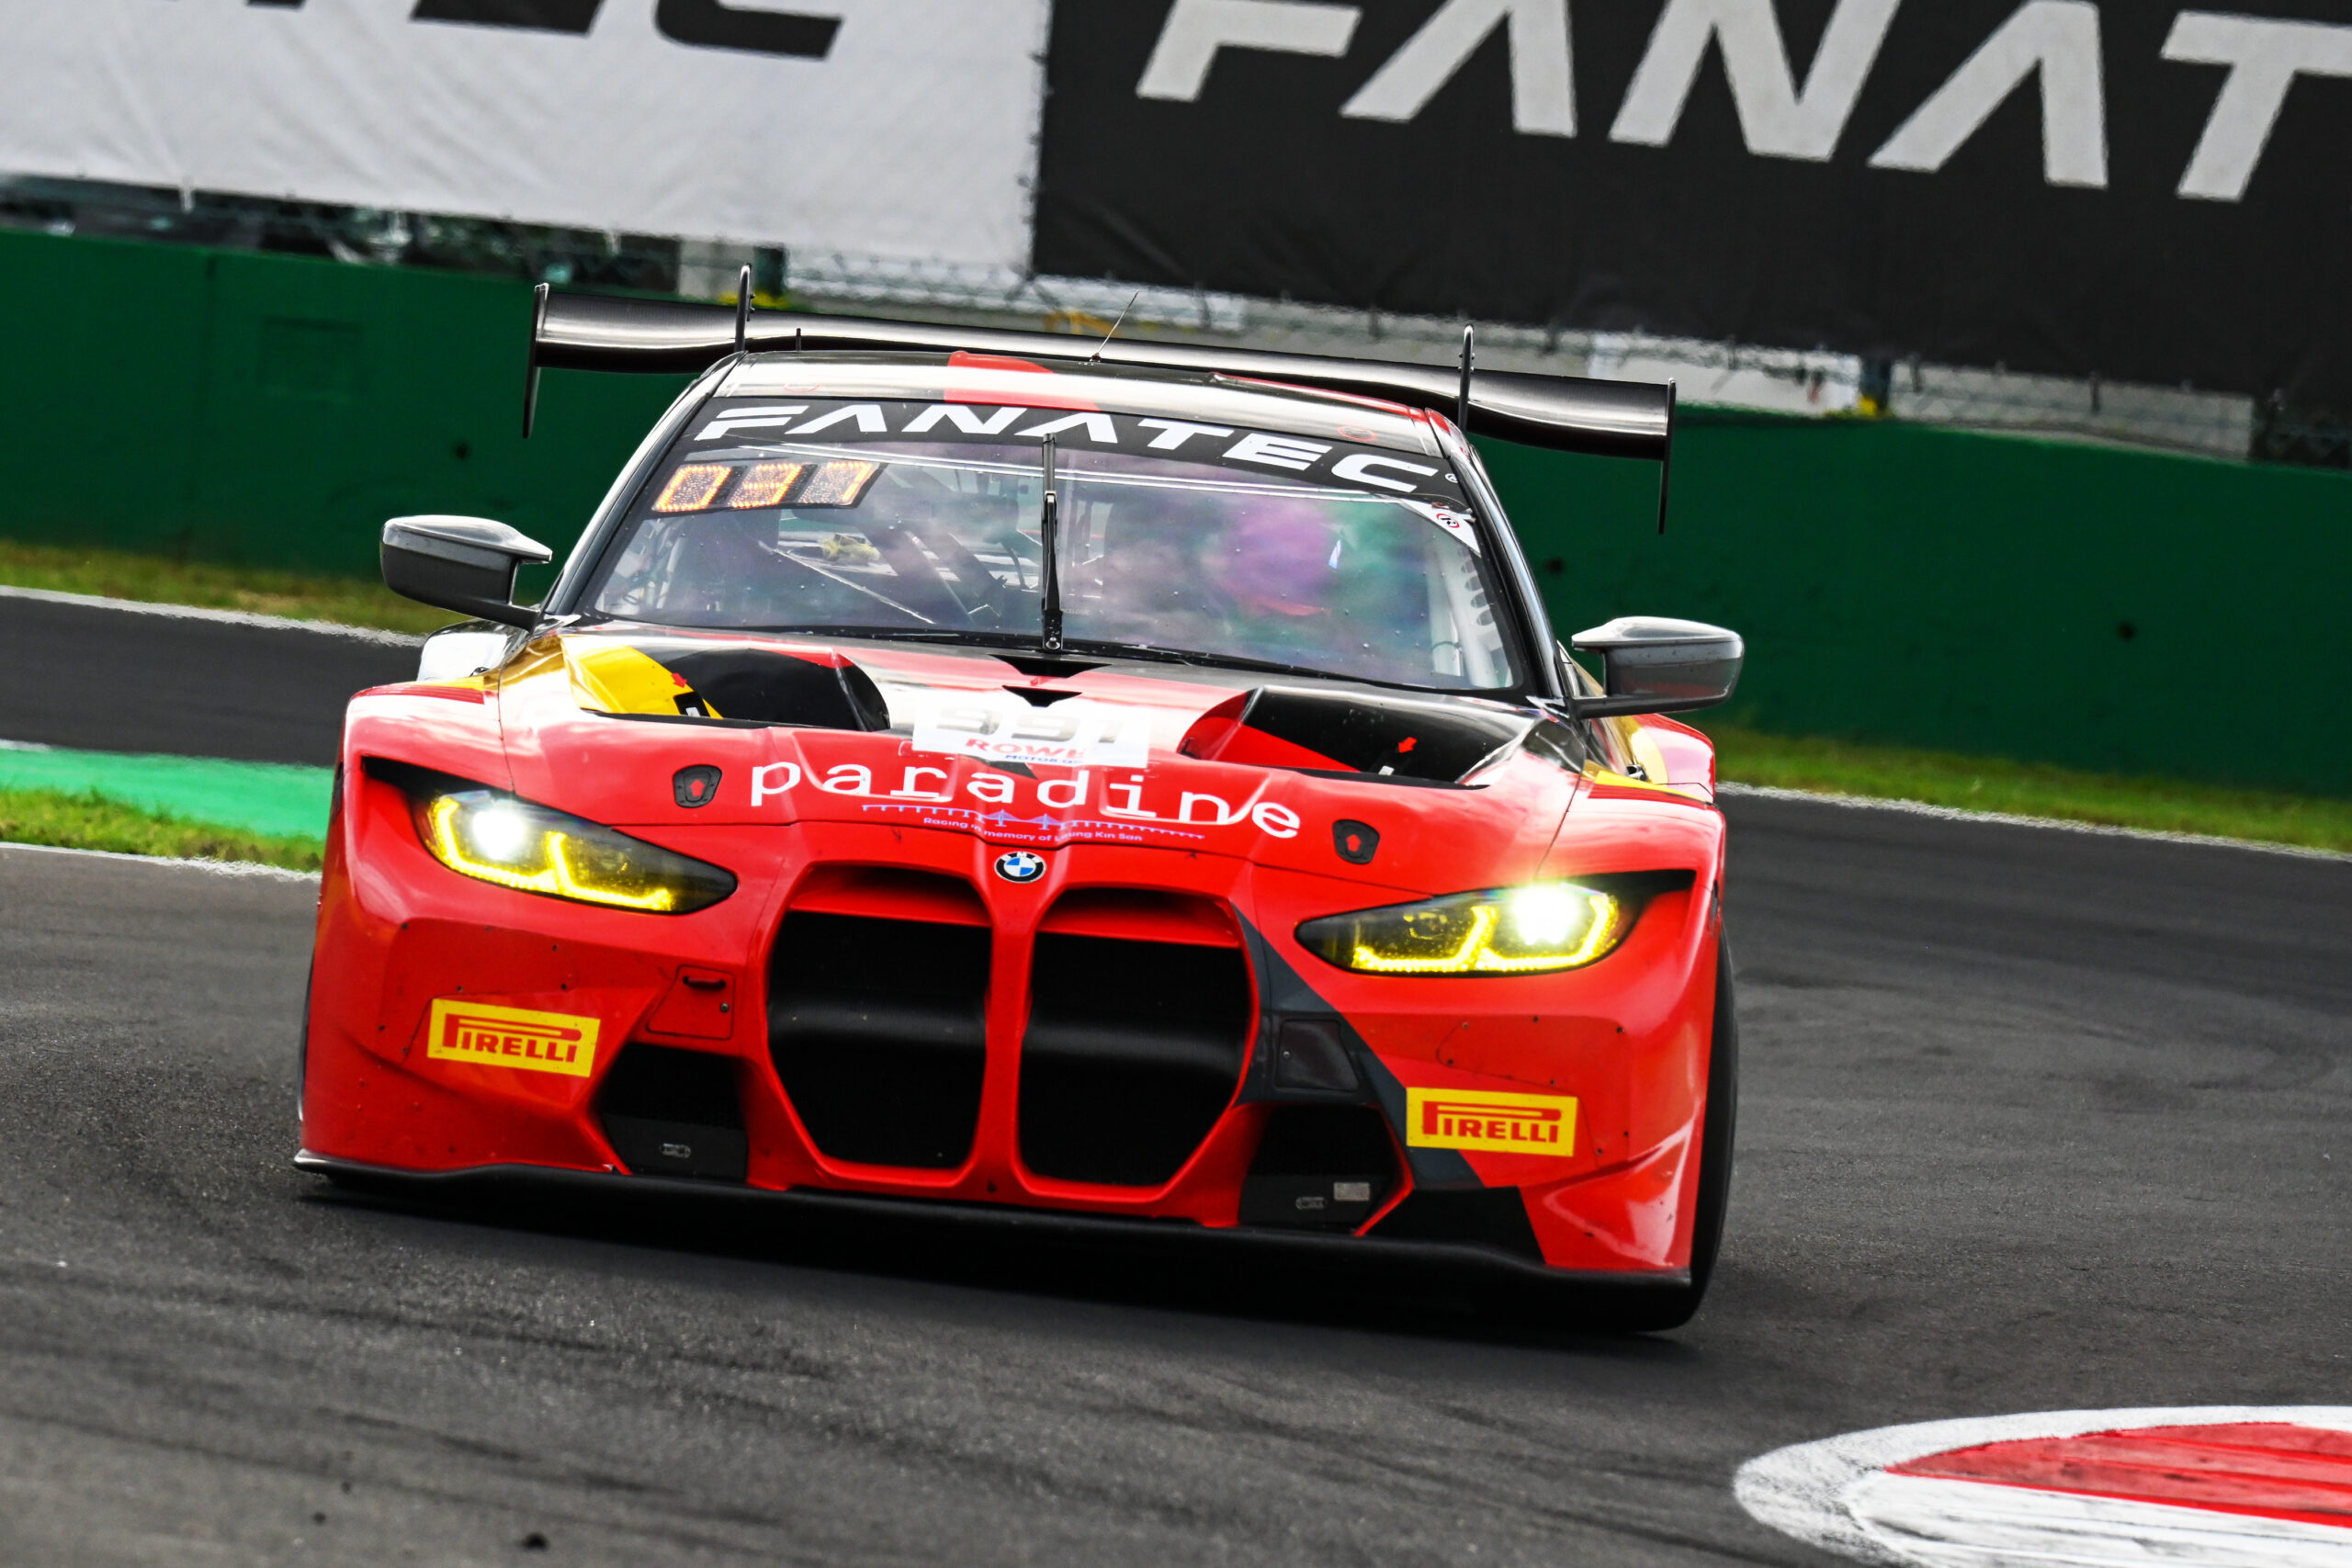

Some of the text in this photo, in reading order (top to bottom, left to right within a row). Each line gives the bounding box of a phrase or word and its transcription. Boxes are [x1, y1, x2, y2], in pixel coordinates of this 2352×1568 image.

[697, 403, 1440, 494] FANATEC
[750, 761, 1302, 840] paradine
[923, 817, 968, 829] Racing
[983, 829, 1035, 841] memory
[1038, 833, 1053, 842] of
[1118, 832, 1143, 842] San
[442, 1012, 582, 1064] PIRELLI
[1421, 1100, 1562, 1144] PIRELLI
